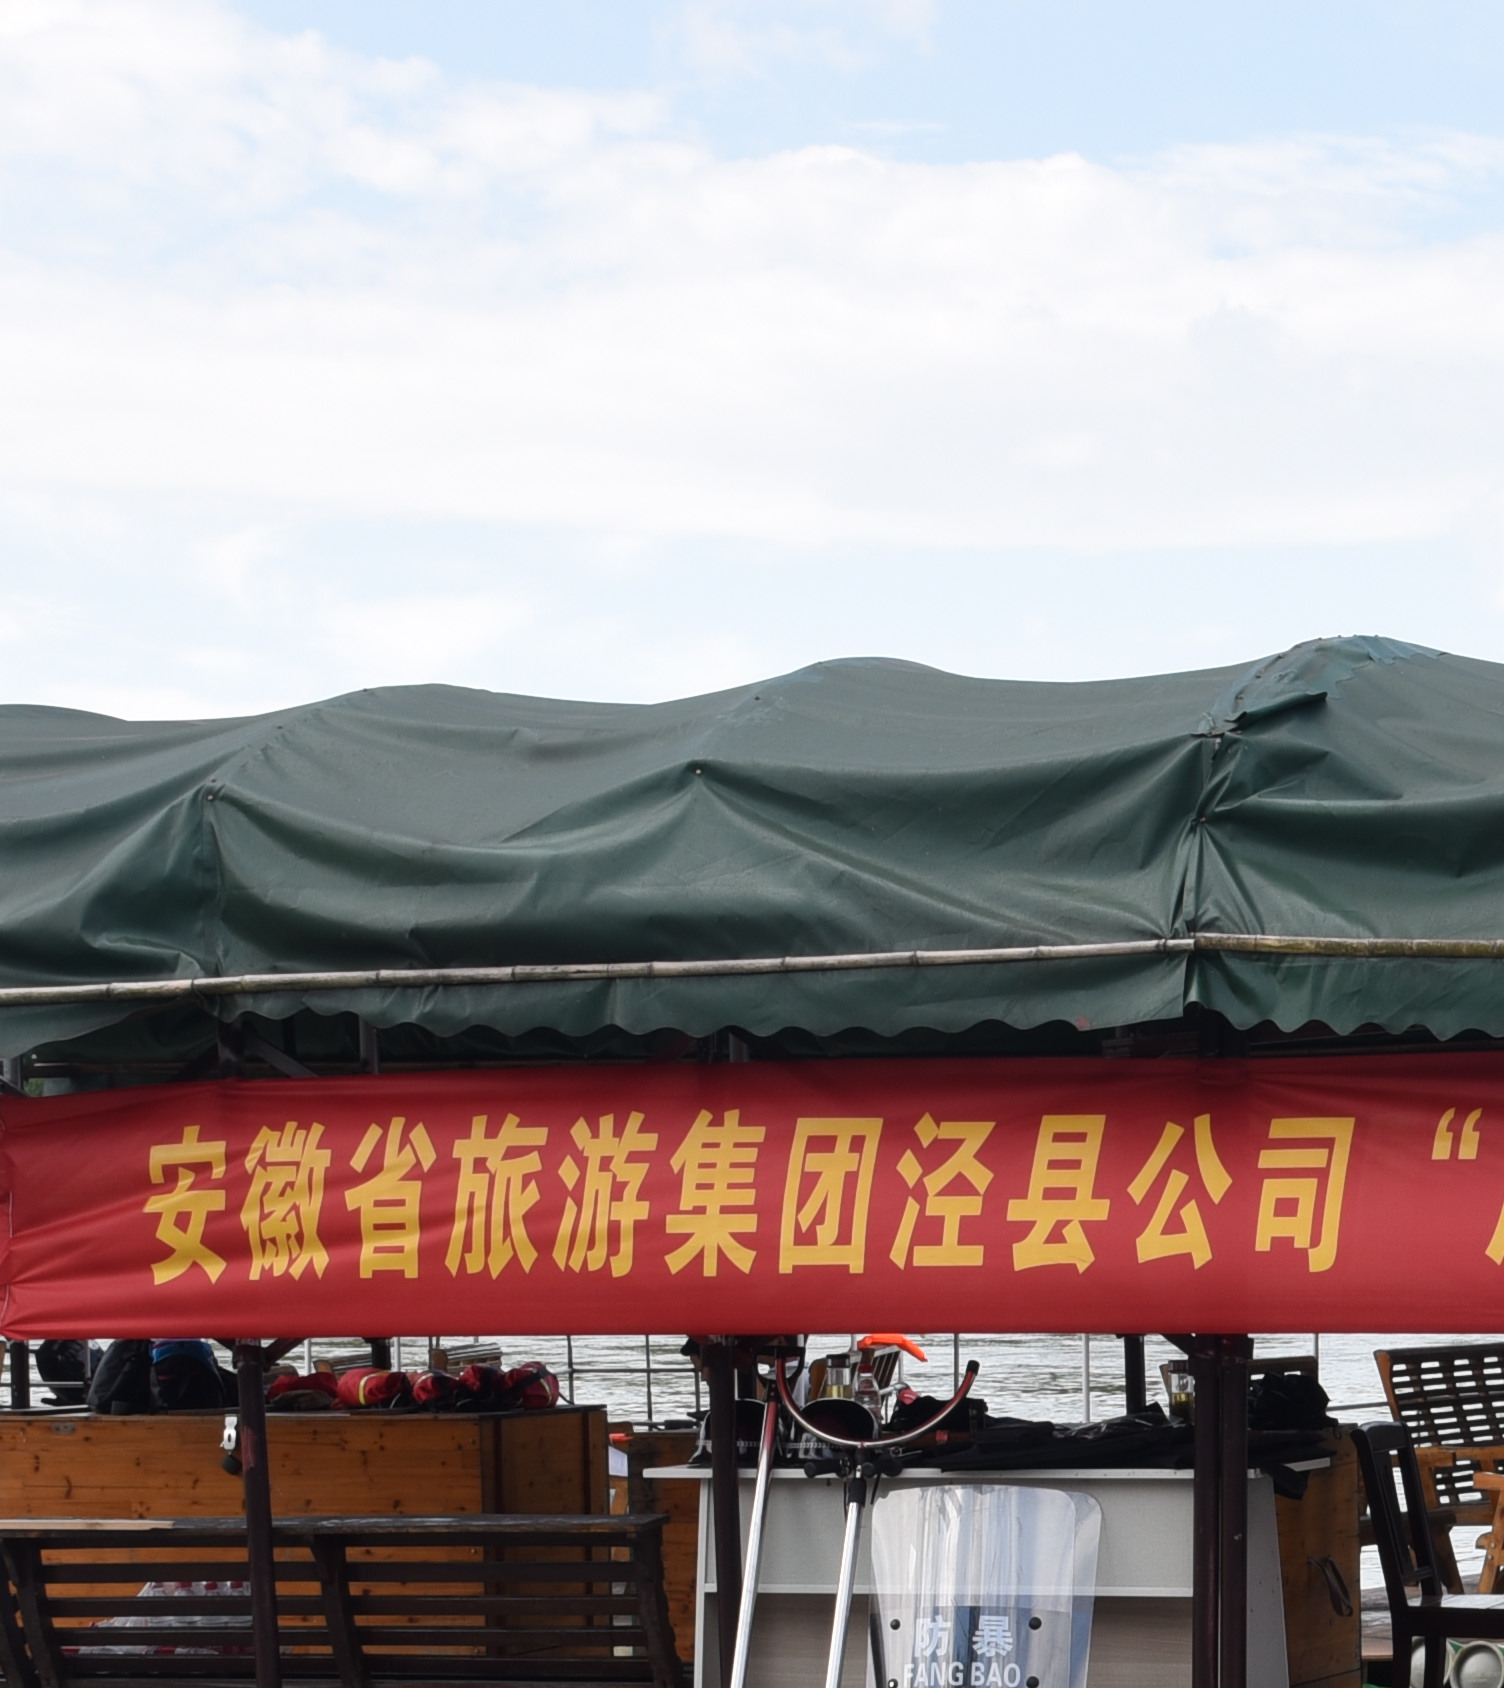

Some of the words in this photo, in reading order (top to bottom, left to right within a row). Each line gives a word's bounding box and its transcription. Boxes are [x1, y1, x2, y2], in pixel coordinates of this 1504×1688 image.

[914, 1615, 1013, 1658] 防暴
[903, 1661, 964, 1687] FANG
[970, 1662, 1021, 1688] BAO
